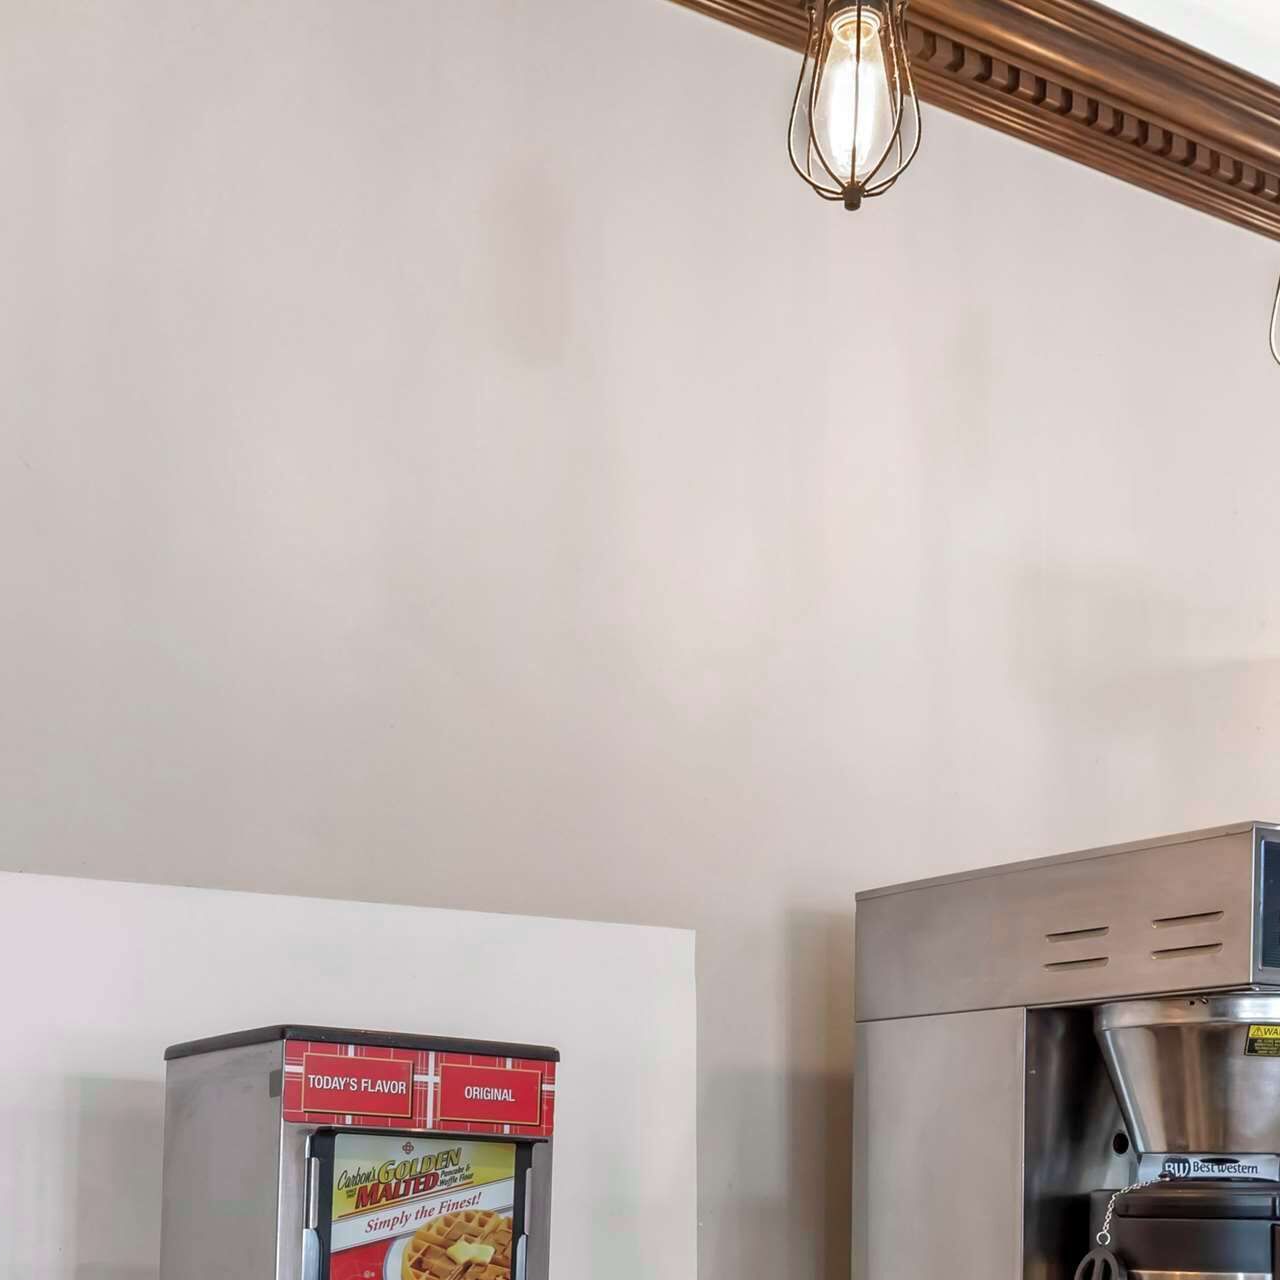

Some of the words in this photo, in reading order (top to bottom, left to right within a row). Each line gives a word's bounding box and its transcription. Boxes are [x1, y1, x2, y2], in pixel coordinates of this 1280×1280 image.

[308, 1074, 358, 1091] TODAY'S
[361, 1078, 407, 1095] FLAVOR
[464, 1086, 515, 1102] ORIGINAL
[377, 1147, 462, 1185] GOLDEN
[1193, 1161, 1215, 1173] Best
[354, 1171, 440, 1210] MALTED
[365, 1210, 412, 1233] Simply
[415, 1205, 435, 1220] the
[439, 1192, 482, 1215] Finest!
